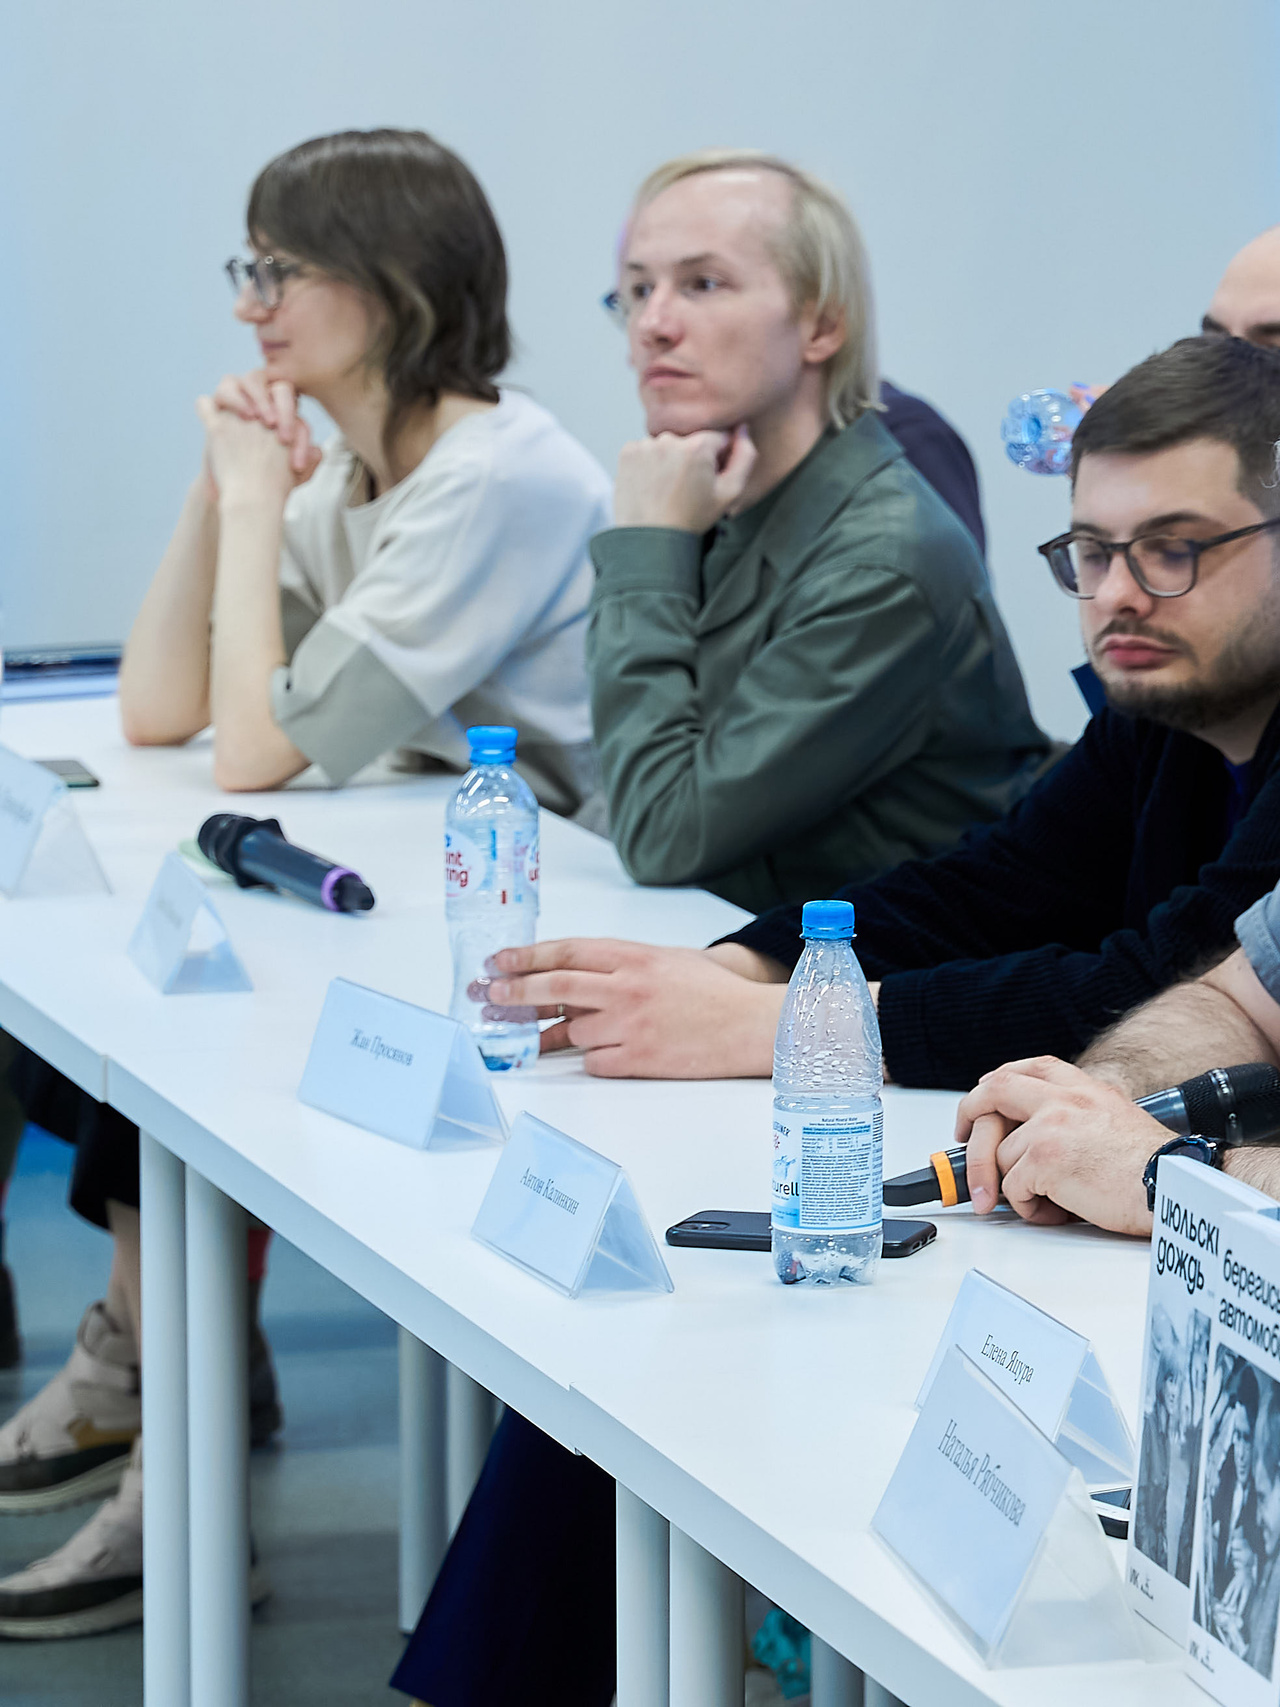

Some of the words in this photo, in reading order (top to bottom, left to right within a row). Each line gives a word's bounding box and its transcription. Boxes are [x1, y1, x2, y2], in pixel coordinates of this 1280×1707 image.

[520, 1167, 545, 1194] Антон
[542, 1178, 579, 1215] Калинкин
[981, 1334, 1008, 1366] Елена
[1005, 1350, 1034, 1385] Яцура
[938, 1419, 979, 1480] Наталья
[973, 1453, 1026, 1527] Рябчикова
